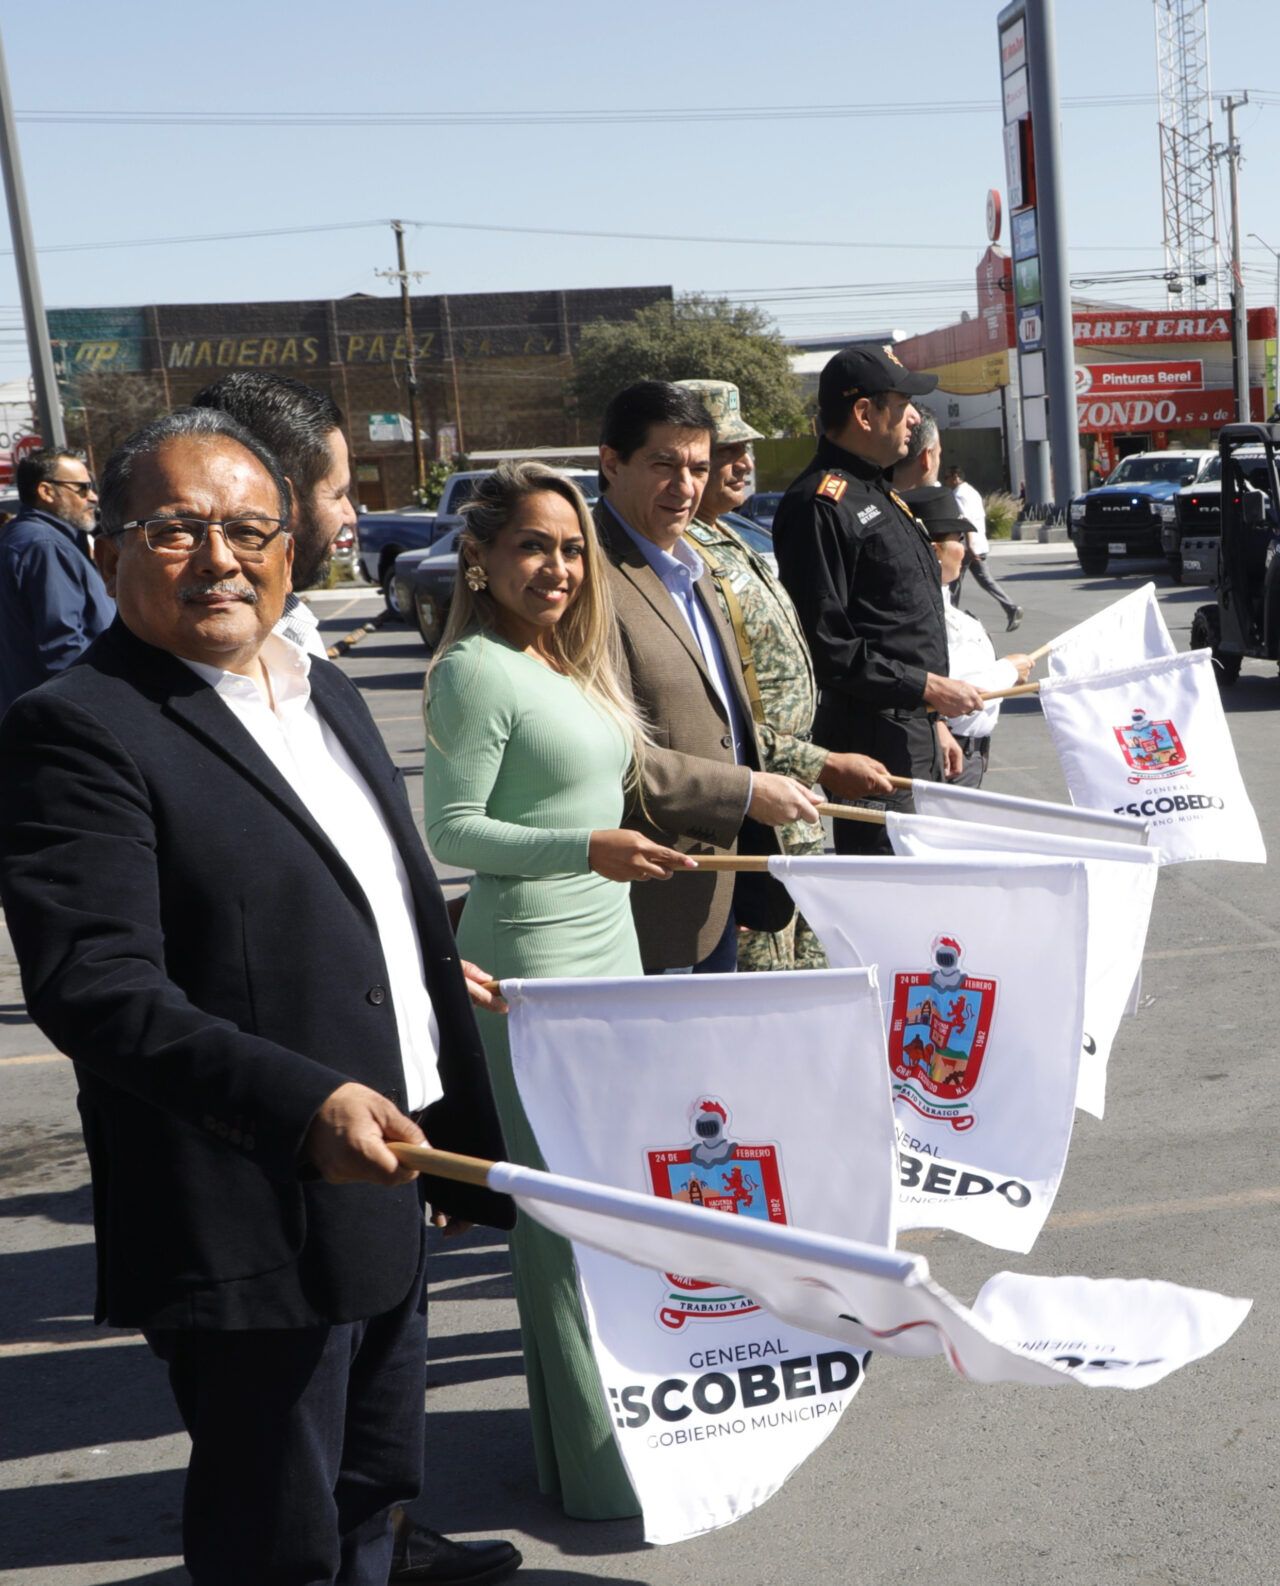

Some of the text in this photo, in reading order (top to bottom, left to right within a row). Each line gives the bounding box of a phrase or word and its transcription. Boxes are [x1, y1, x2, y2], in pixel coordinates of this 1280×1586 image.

[168, 337, 320, 368] MADERAS
[346, 332, 435, 362] PAEZ
[1102, 370, 1192, 386] Pinturas Berel
[1213, 408, 1229, 421] de
[965, 979, 992, 991] FEBRERO
[655, 1152, 678, 1163] 24 DE
[736, 1148, 771, 1158] FEBRERO
[770, 1198, 782, 1217] 1982
[680, 1301, 727, 1312] TRABAJO
[730, 1302, 738, 1310] Y
[689, 1338, 789, 1369] GENERAL
[608, 1350, 873, 1429] SCOBED
[647, 1419, 746, 1449] GOBIERNO
